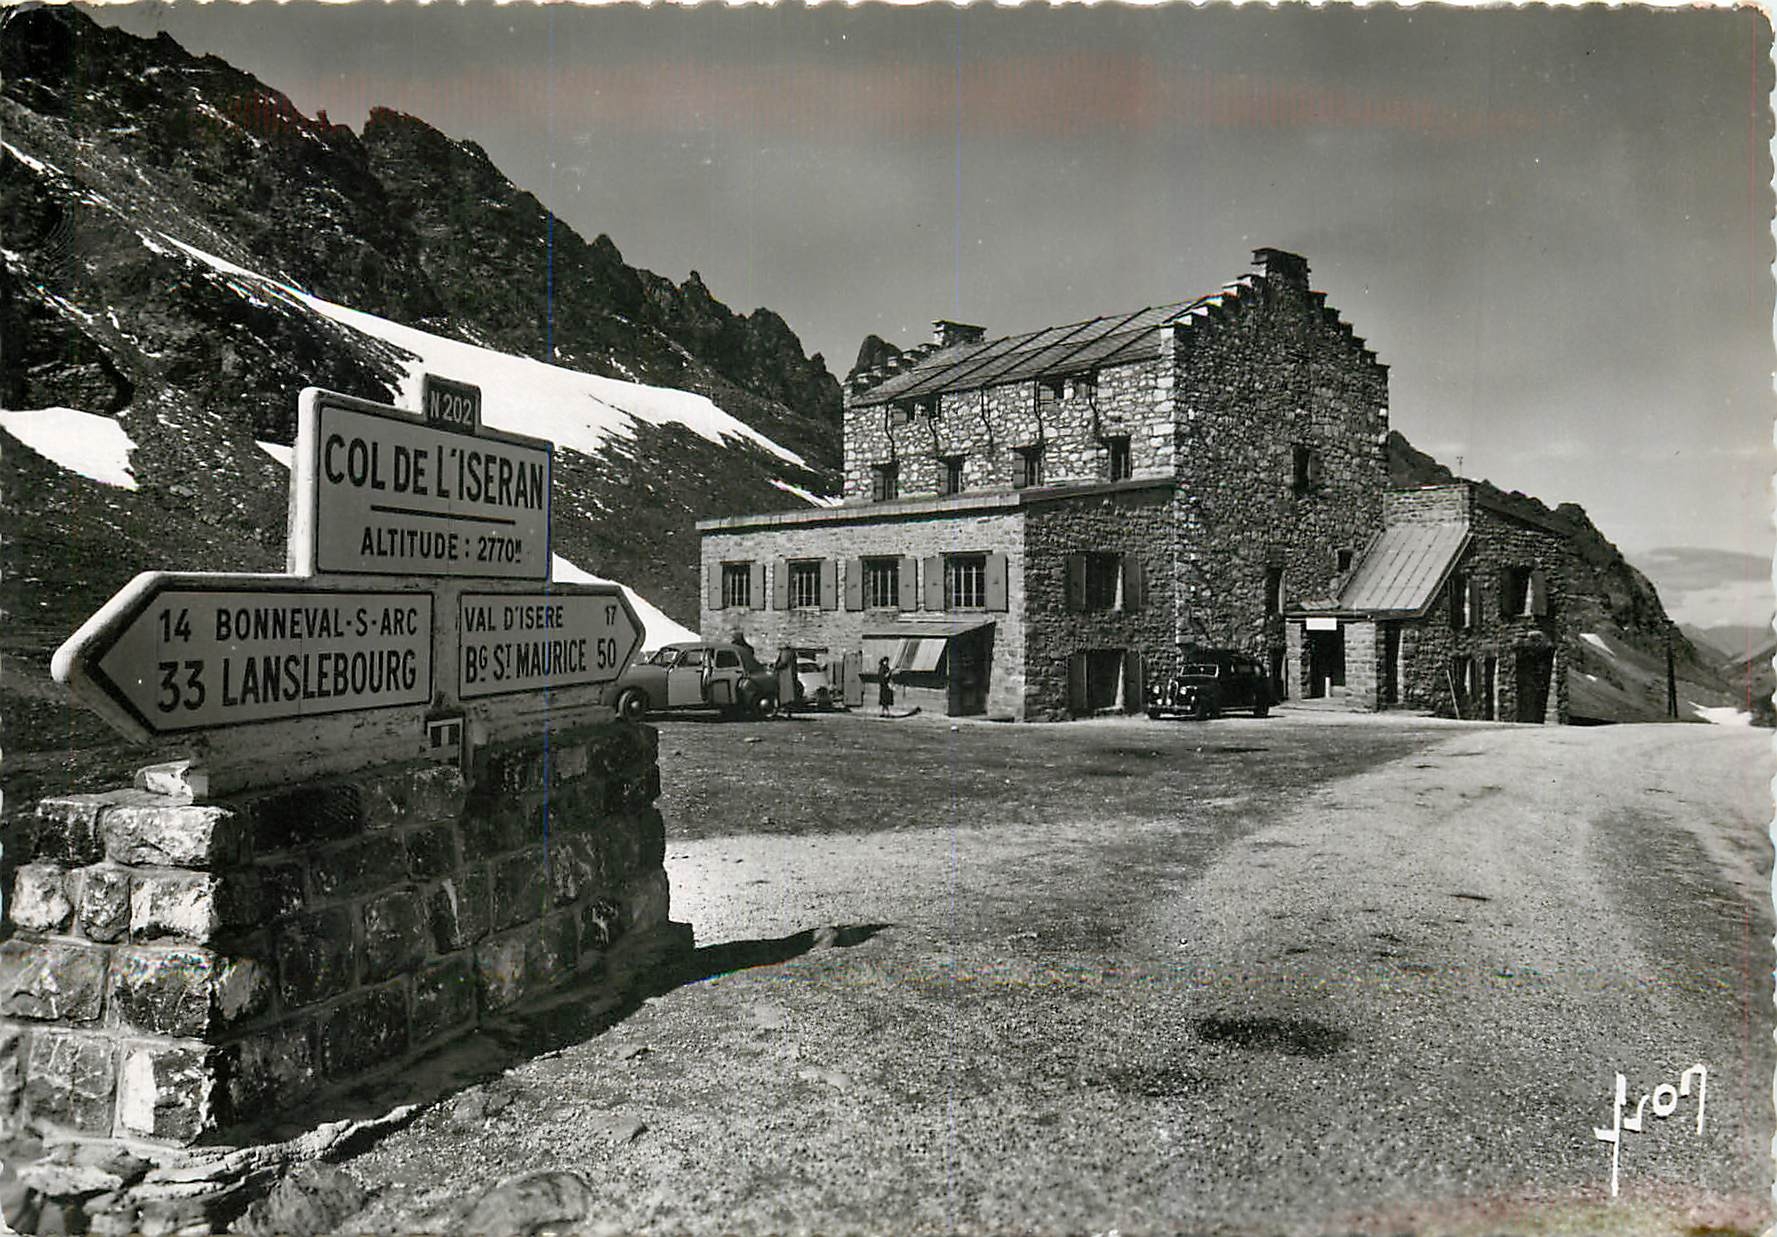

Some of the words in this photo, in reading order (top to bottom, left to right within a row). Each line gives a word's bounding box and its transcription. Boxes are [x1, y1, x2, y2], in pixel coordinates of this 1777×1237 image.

[324, 433, 386, 491] COL
[393, 445, 429, 496] DE
[436, 445, 544, 511] L'ISERAN
[159, 608, 191, 643] 14
[465, 606, 496, 632] VAL
[504, 605, 564, 631] D'ISERE
[605, 605, 617, 626] 17
[516, 638, 586, 679] MAURICE
[597, 638, 617, 670] 50
[157, 659, 205, 713] 33
[221, 648, 417, 707] LANSLEBOURG
